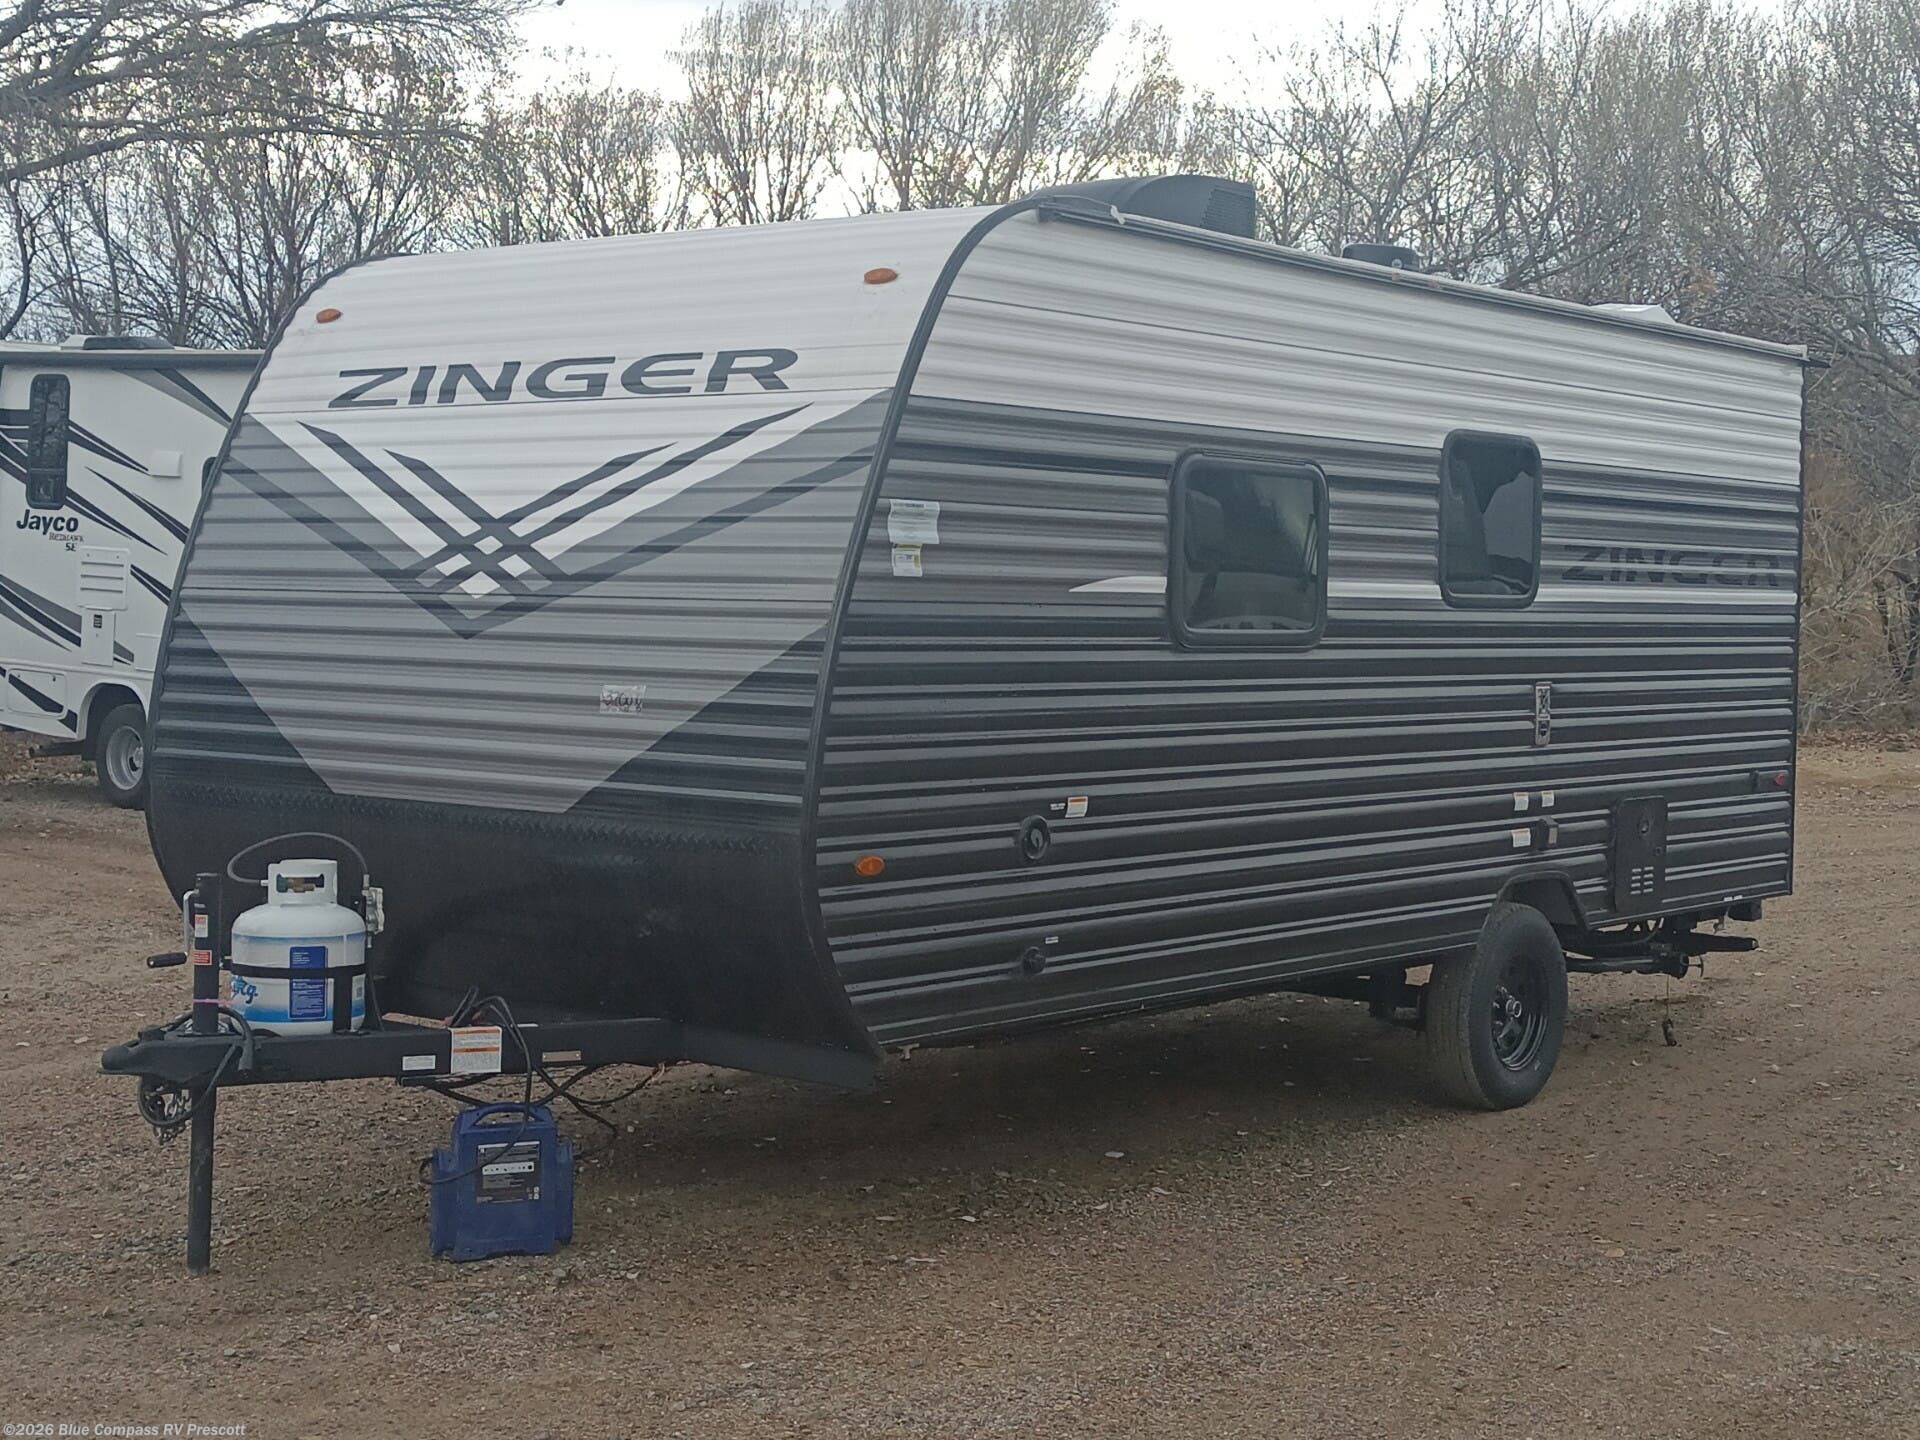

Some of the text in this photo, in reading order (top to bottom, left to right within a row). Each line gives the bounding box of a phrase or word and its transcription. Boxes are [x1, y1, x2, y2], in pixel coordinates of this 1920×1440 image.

[328, 348, 798, 408] ZINGER
[16, 509, 79, 535] Jayco
[1562, 544, 1780, 587] ZINGER
